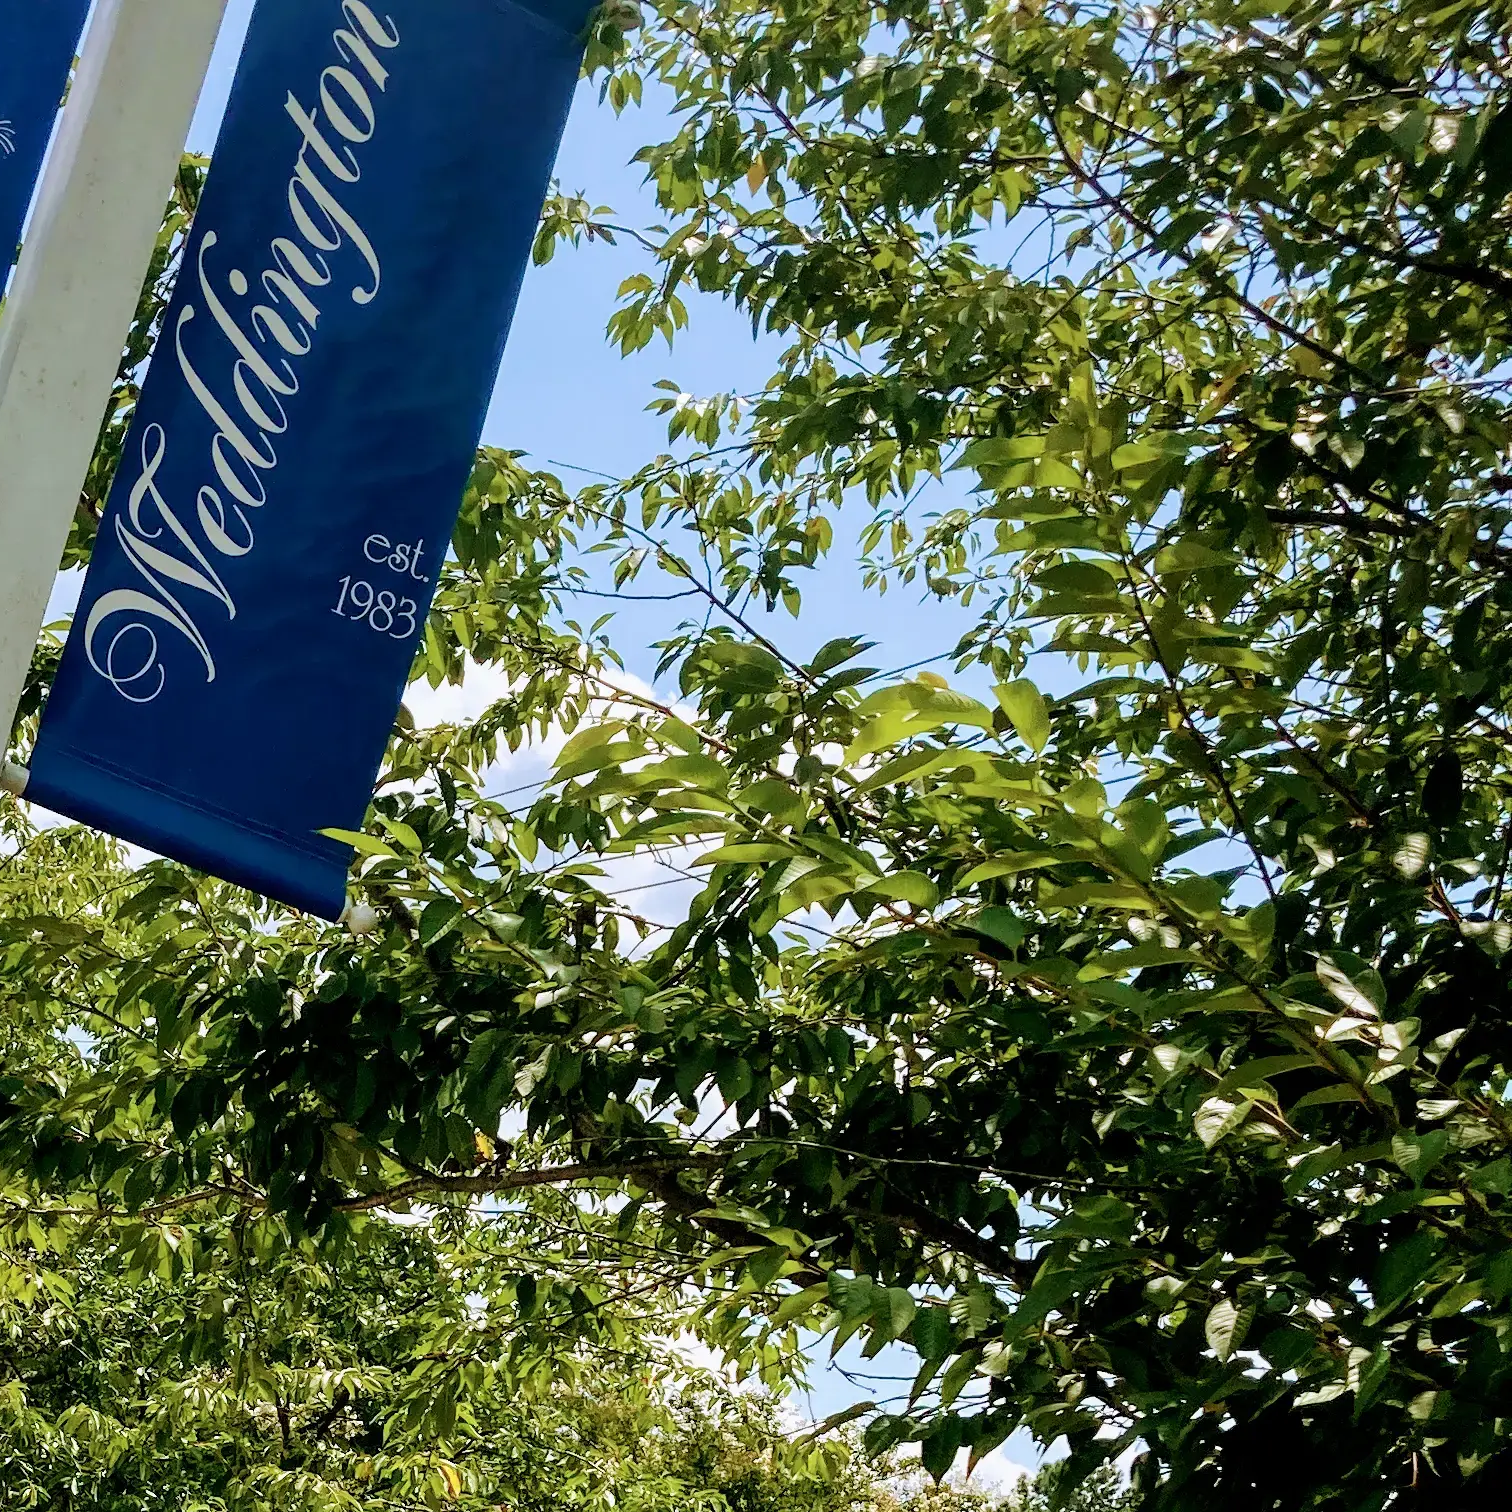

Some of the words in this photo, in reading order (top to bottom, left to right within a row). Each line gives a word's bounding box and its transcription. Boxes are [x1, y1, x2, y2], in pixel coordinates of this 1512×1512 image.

[85, 0, 400, 702] Weddington
[363, 533, 430, 583] est.
[330, 575, 417, 639] 1983
